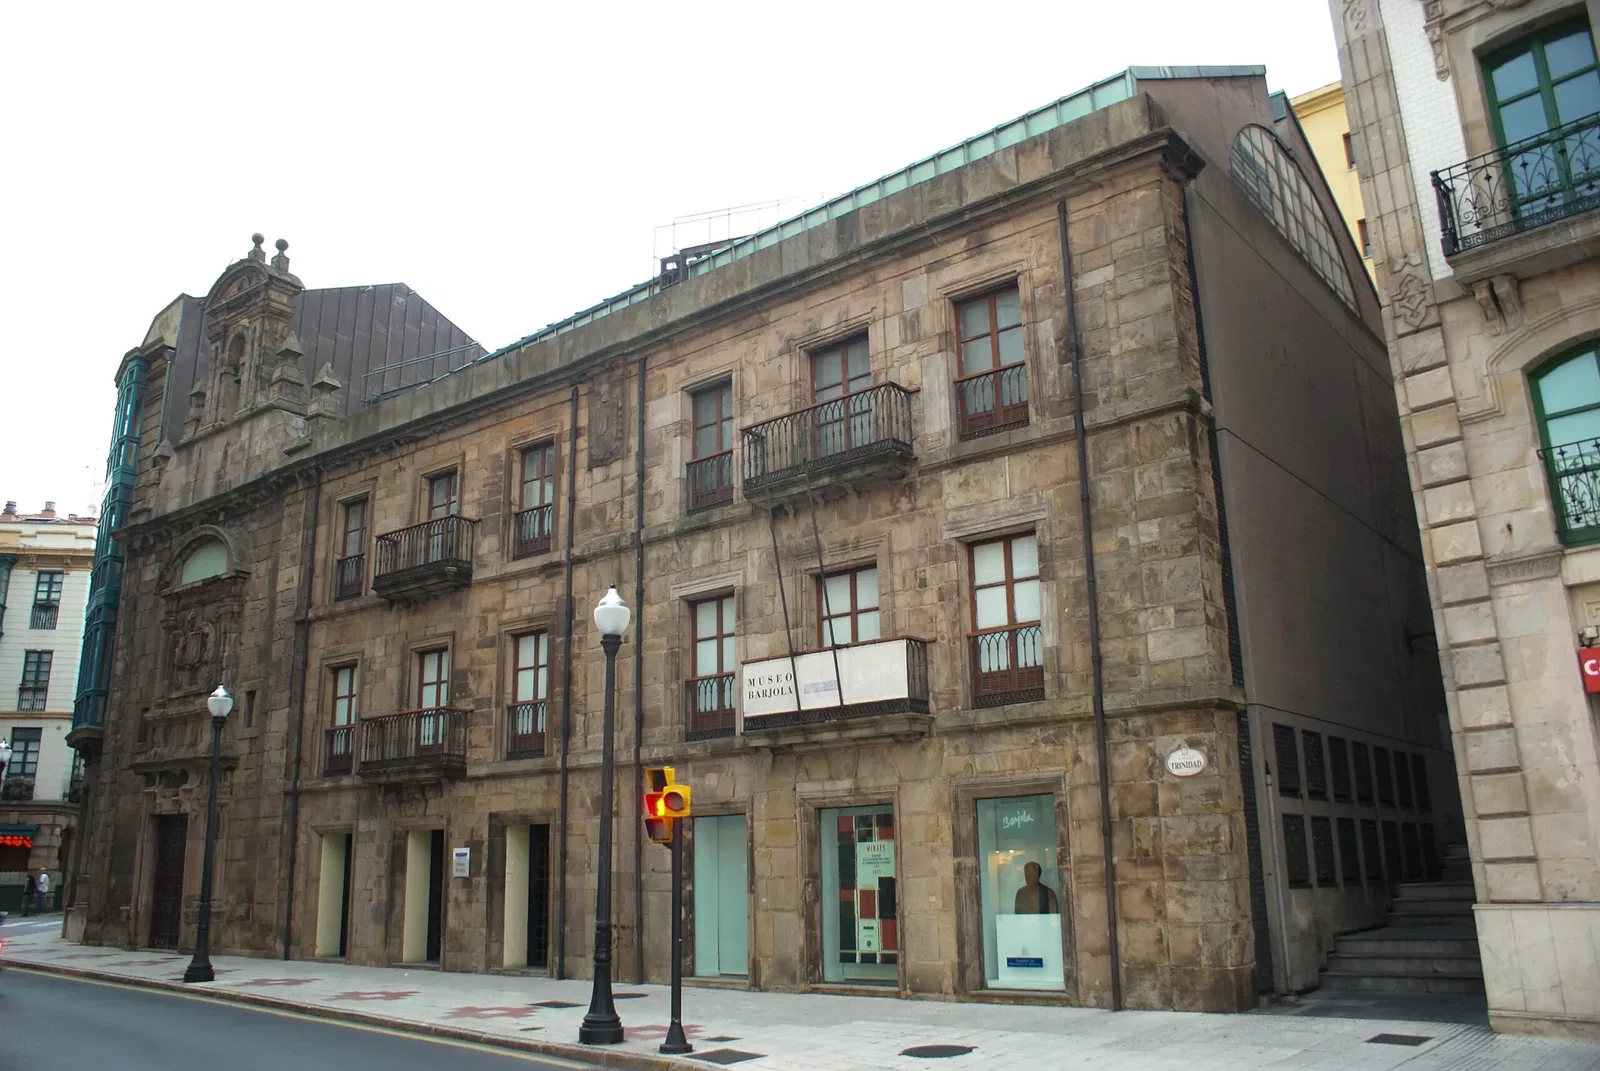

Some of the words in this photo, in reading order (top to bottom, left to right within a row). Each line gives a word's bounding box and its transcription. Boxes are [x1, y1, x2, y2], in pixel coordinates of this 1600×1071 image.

[1584, 659, 1600, 676] C
[748, 673, 792, 687] MUSEO
[748, 686, 793, 700] BARJOLA
[1170, 759, 1202, 770] TRINIDAD
